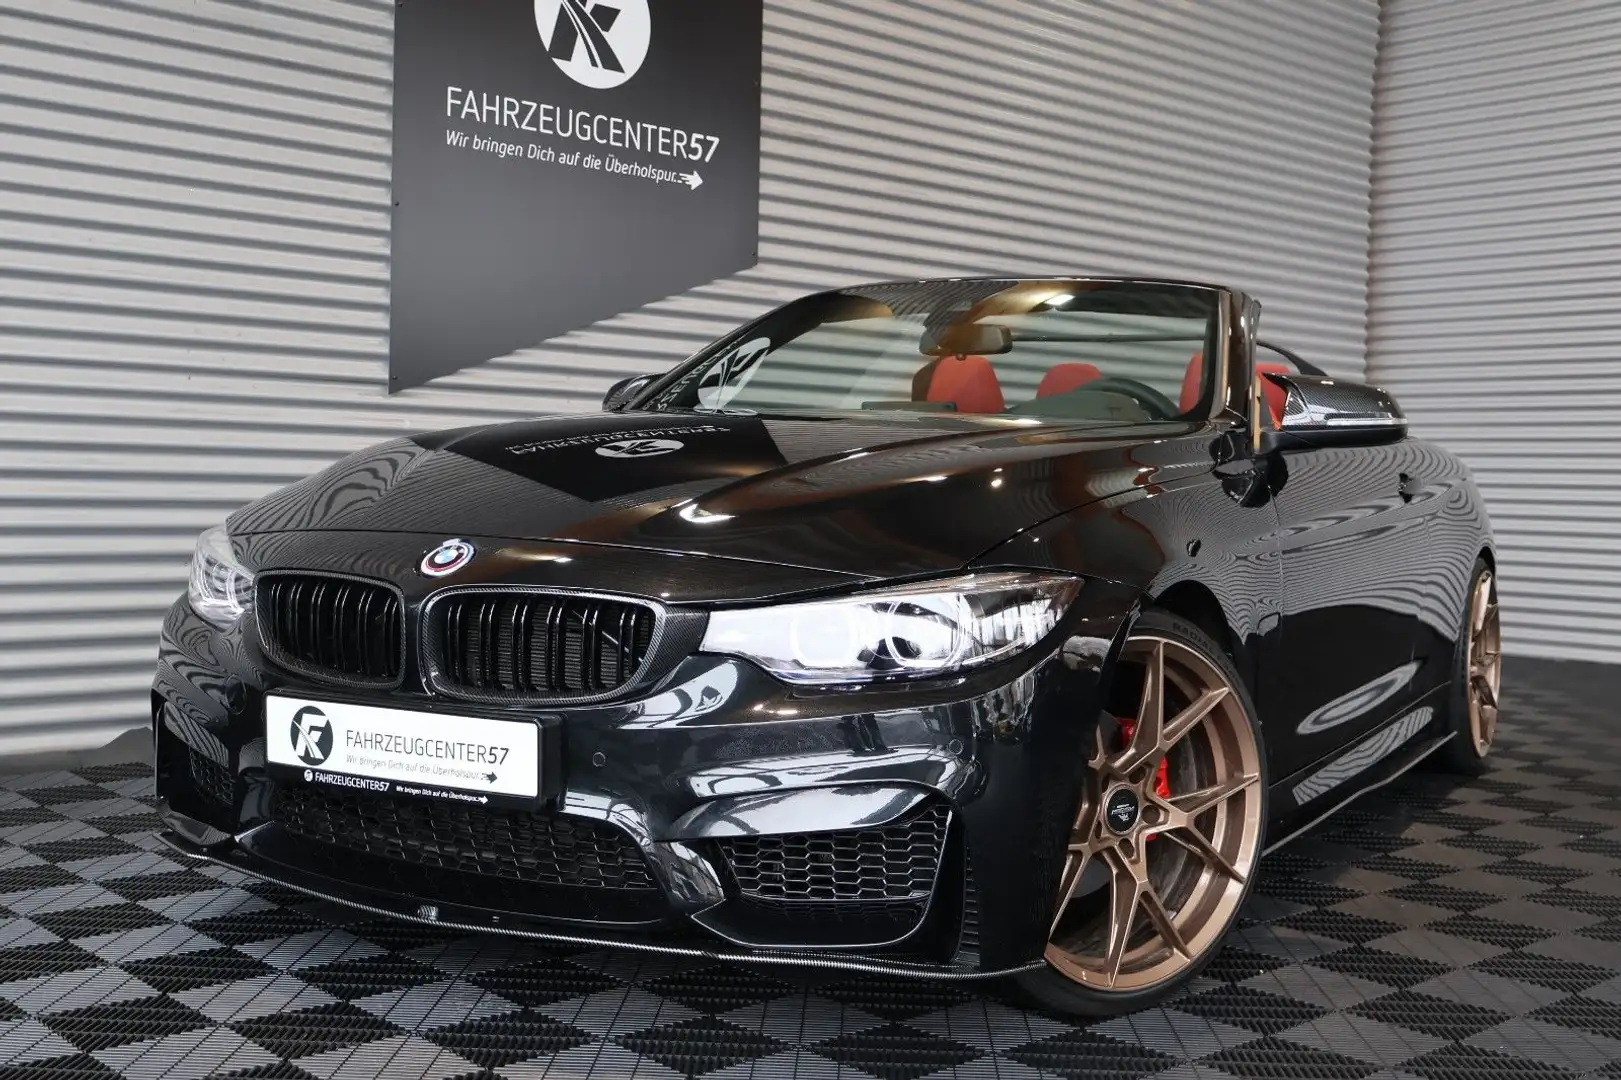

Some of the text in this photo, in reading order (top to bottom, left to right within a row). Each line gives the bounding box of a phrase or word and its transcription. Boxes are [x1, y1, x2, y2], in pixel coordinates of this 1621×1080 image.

[446, 86, 720, 163] FAHRZEUGCENTER57
[446, 129, 470, 148] Wir
[472, 134, 524, 158] bringen
[527, 143, 555, 163] Dich
[558, 152, 581, 167] auf
[583, 153, 602, 171] die
[346, 729, 510, 766] FAHRZEUGCENTER57
[359, 755, 387, 768] bringen
[405, 763, 418, 772] auf
[419, 763, 431, 774] die
[314, 771, 390, 792] FAHRZEUGCENTER57
